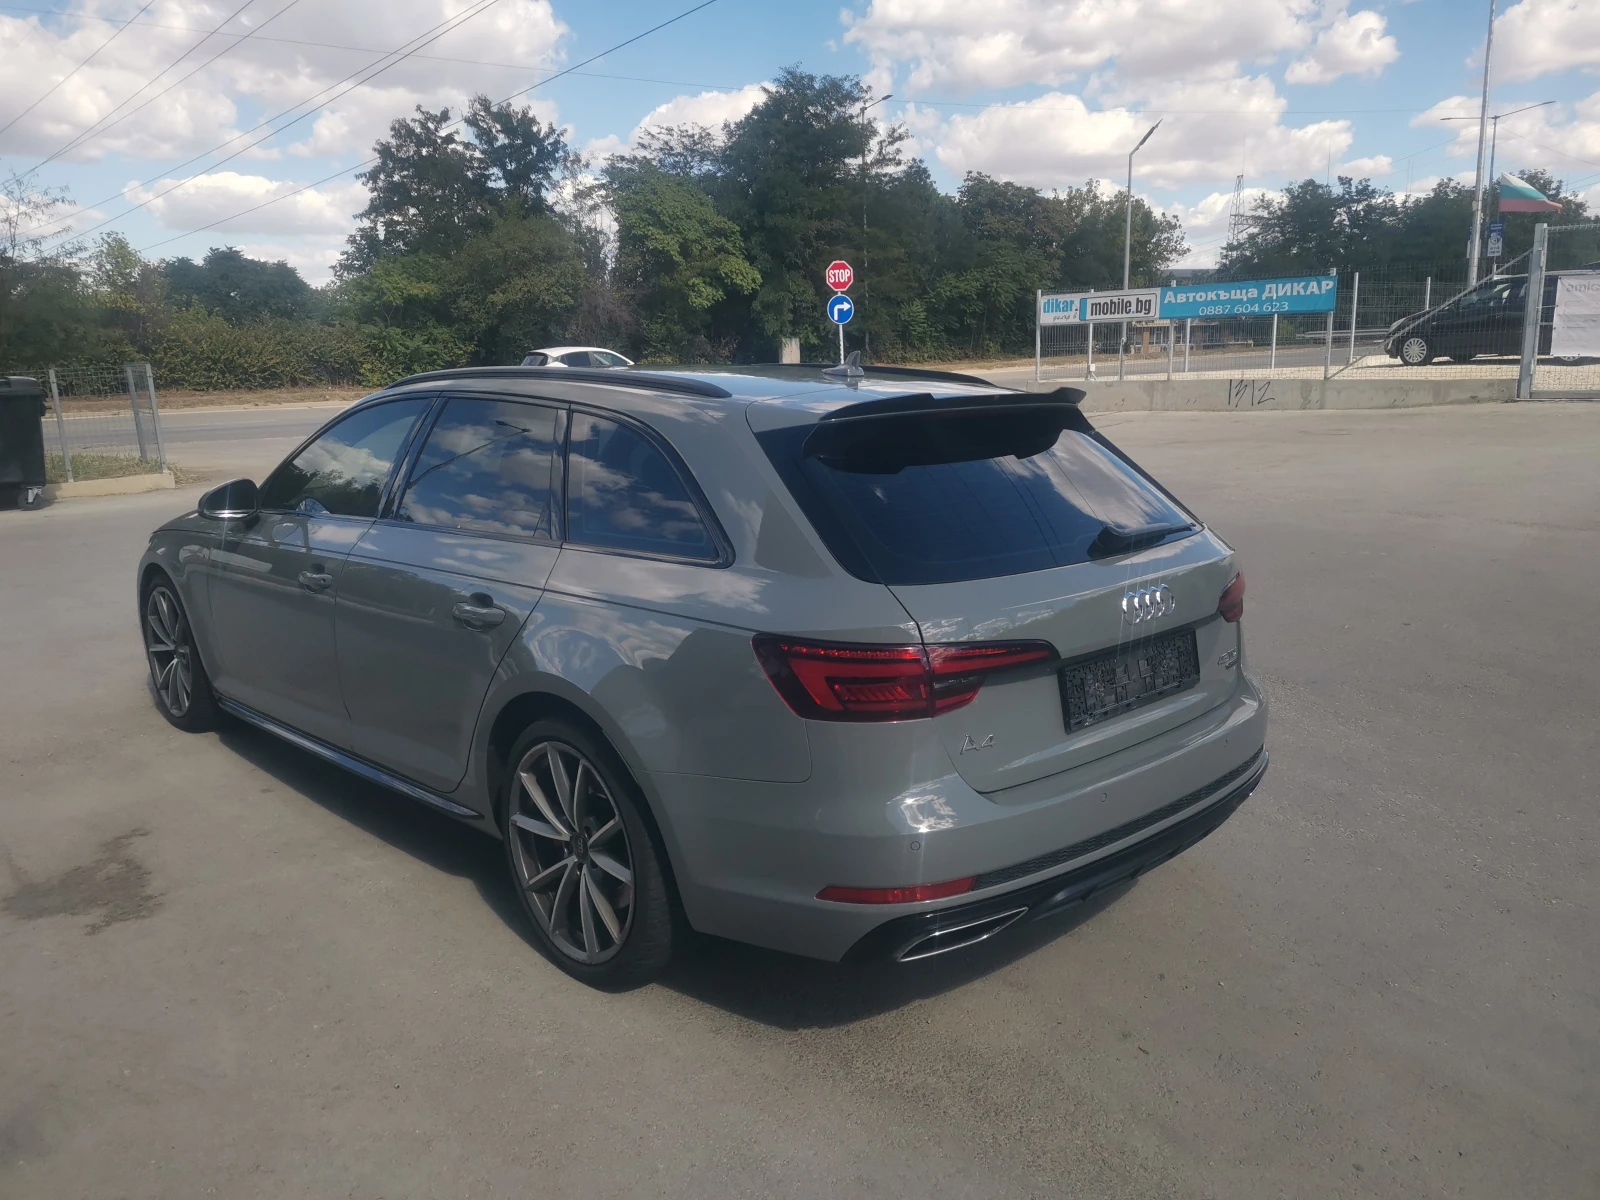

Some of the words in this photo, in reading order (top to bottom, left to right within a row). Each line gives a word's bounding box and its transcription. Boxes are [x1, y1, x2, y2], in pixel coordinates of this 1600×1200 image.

[829, 269, 850, 283] STOP
[1164, 288, 1258, 303] Автокъща
[1262, 280, 1334, 300] ДИКАР
[1090, 297, 1152, 316] mobile.bg
[1198, 304, 1231, 316] 0887
[1234, 303, 1259, 314] 604
[1263, 301, 1289, 312] 623
[1228, 379, 1276, 408] 1312
[959, 733, 996, 756] A4
